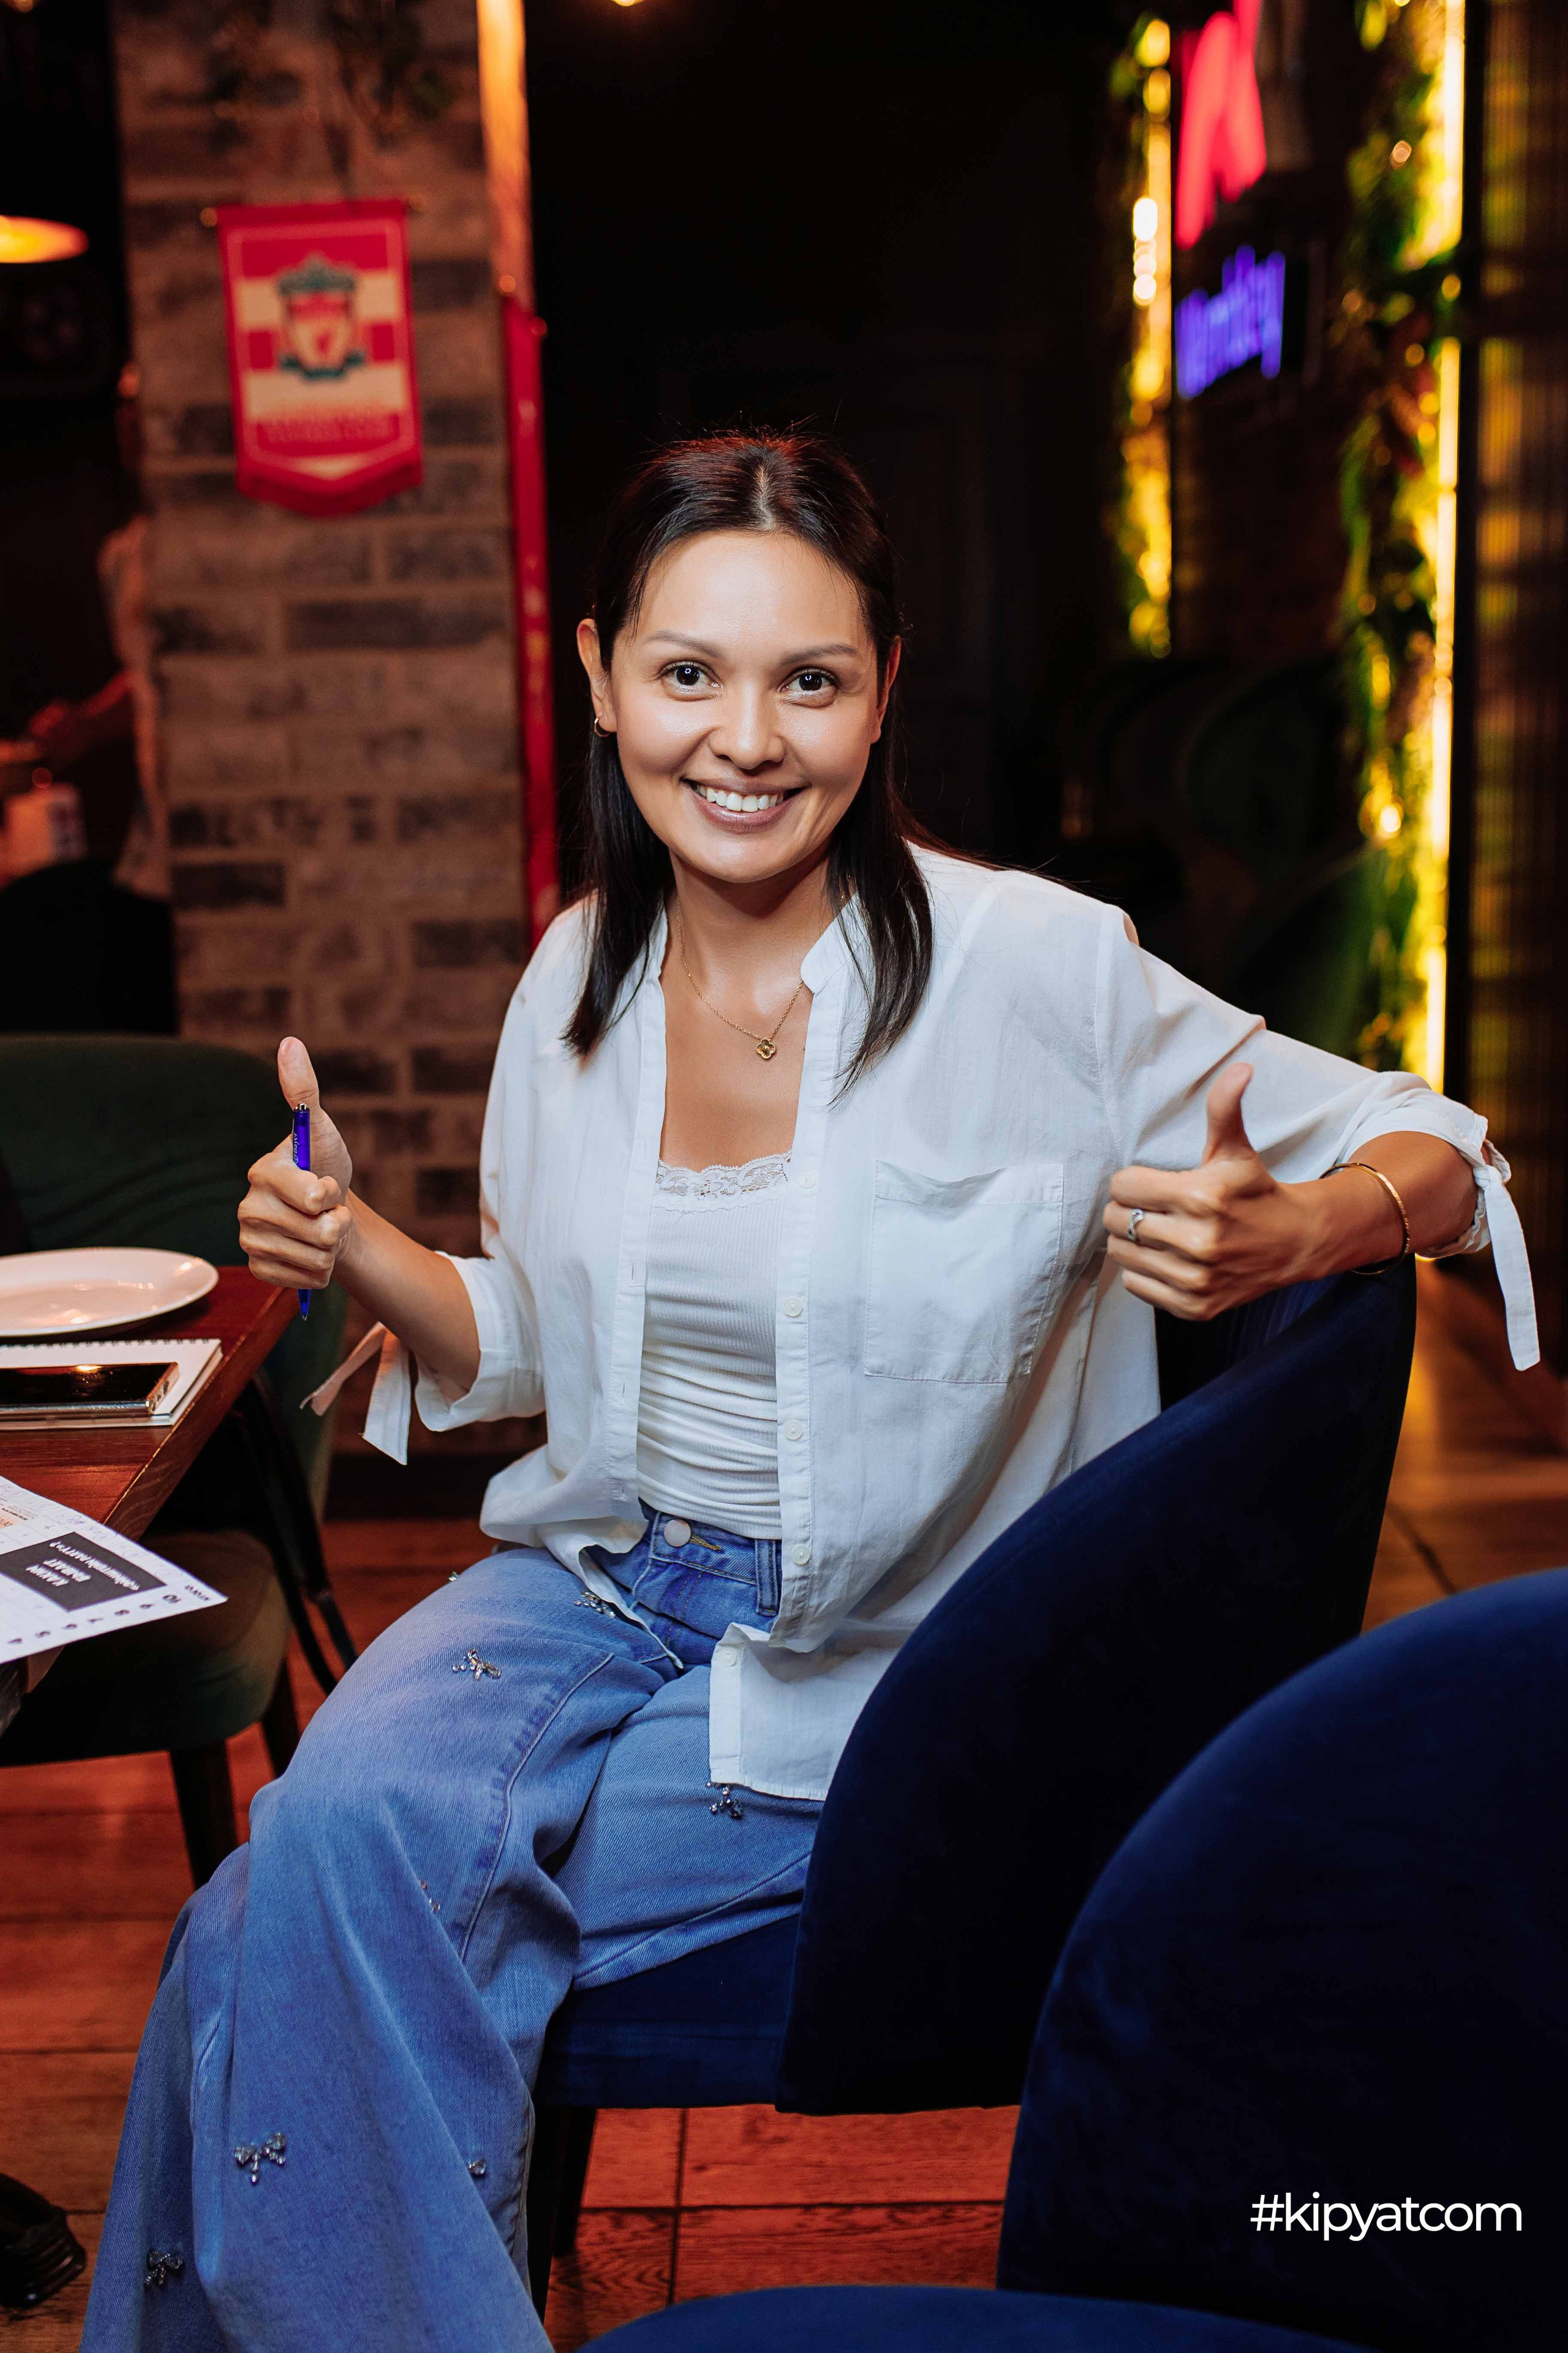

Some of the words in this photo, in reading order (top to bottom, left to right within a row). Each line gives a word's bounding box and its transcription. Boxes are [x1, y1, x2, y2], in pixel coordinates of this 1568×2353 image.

[25, 1564, 70, 1587] КАКИМ
[42, 1558, 91, 1582] БЫВАЕТ
[162, 1594, 182, 1604] 10
